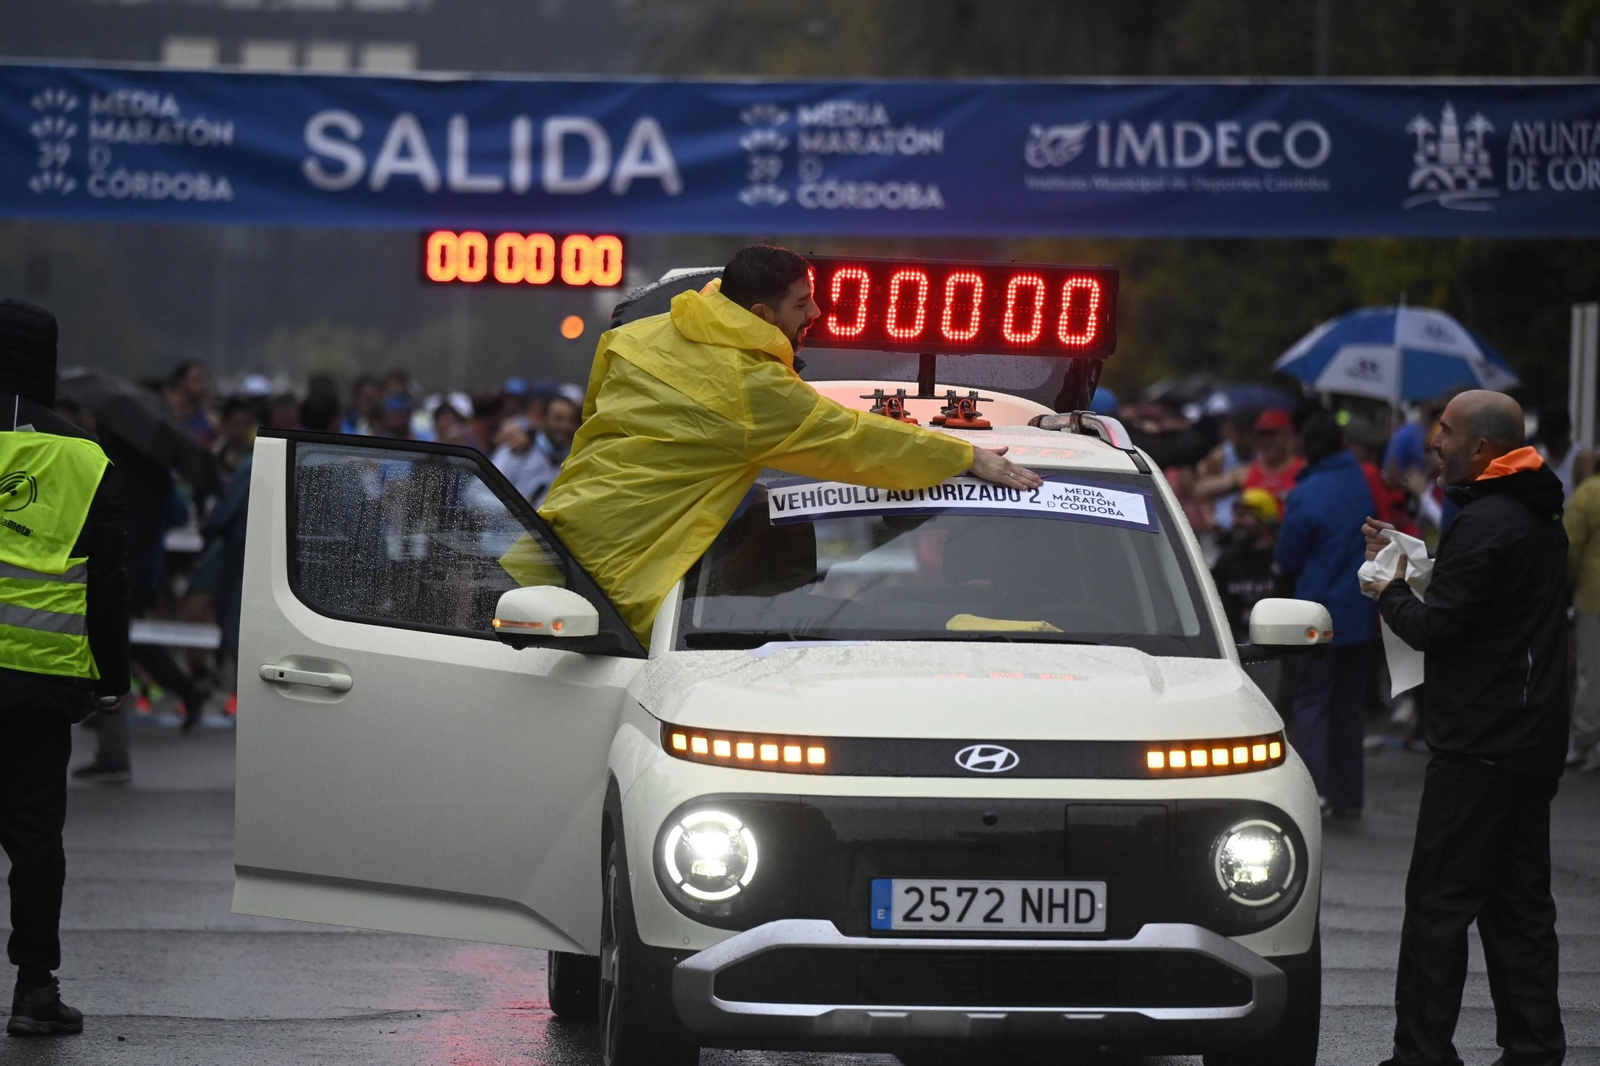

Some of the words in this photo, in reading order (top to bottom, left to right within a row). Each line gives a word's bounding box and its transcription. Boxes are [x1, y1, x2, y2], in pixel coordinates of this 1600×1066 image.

[89, 90, 180, 117] MEDIA
[798, 101, 889, 127] MEDIA
[89, 114, 234, 145] MARATÓN
[799, 123, 944, 154] MARATÓN
[1097, 120, 1331, 168] IMDECO
[303, 110, 684, 195] SALIDA
[88, 166, 234, 199] CÓRDOBA
[1507, 156, 1540, 191] DE
[797, 179, 944, 209] CÓRDOBA
[772, 486, 880, 512] VEHÍCULO
[886, 483, 1021, 502] AUTORIZADO
[1027, 488, 1041, 504] 2
[1053, 493, 1116, 508] MARATÓN
[1064, 487, 1104, 499] MEDIA
[1060, 501, 1125, 517] CÓRDOBA
[877, 909, 886, 920] E
[902, 886, 1005, 923] 2572
[1021, 887, 1096, 924] NHD
